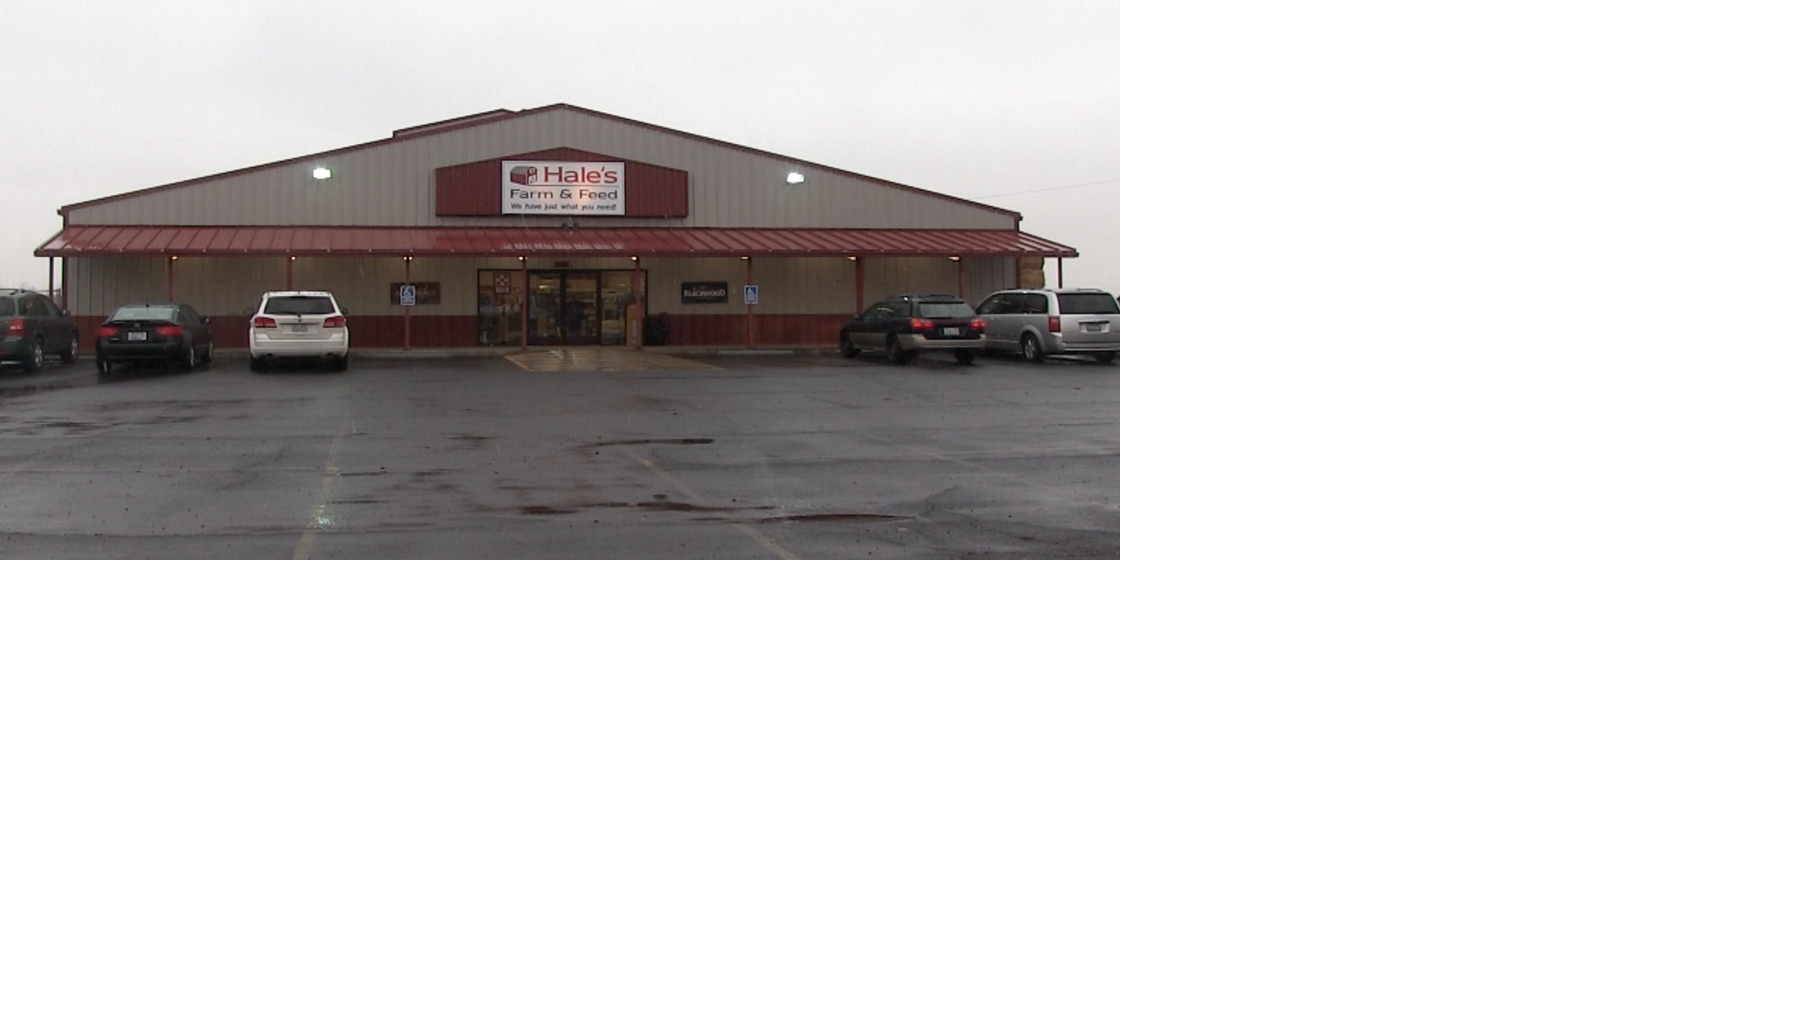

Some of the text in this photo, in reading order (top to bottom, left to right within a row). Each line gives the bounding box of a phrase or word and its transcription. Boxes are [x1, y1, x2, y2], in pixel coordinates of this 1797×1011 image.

[543, 166, 618, 184] Hale's
[510, 188, 618, 199] Farm & Feed
[544, 203, 557, 211] just
